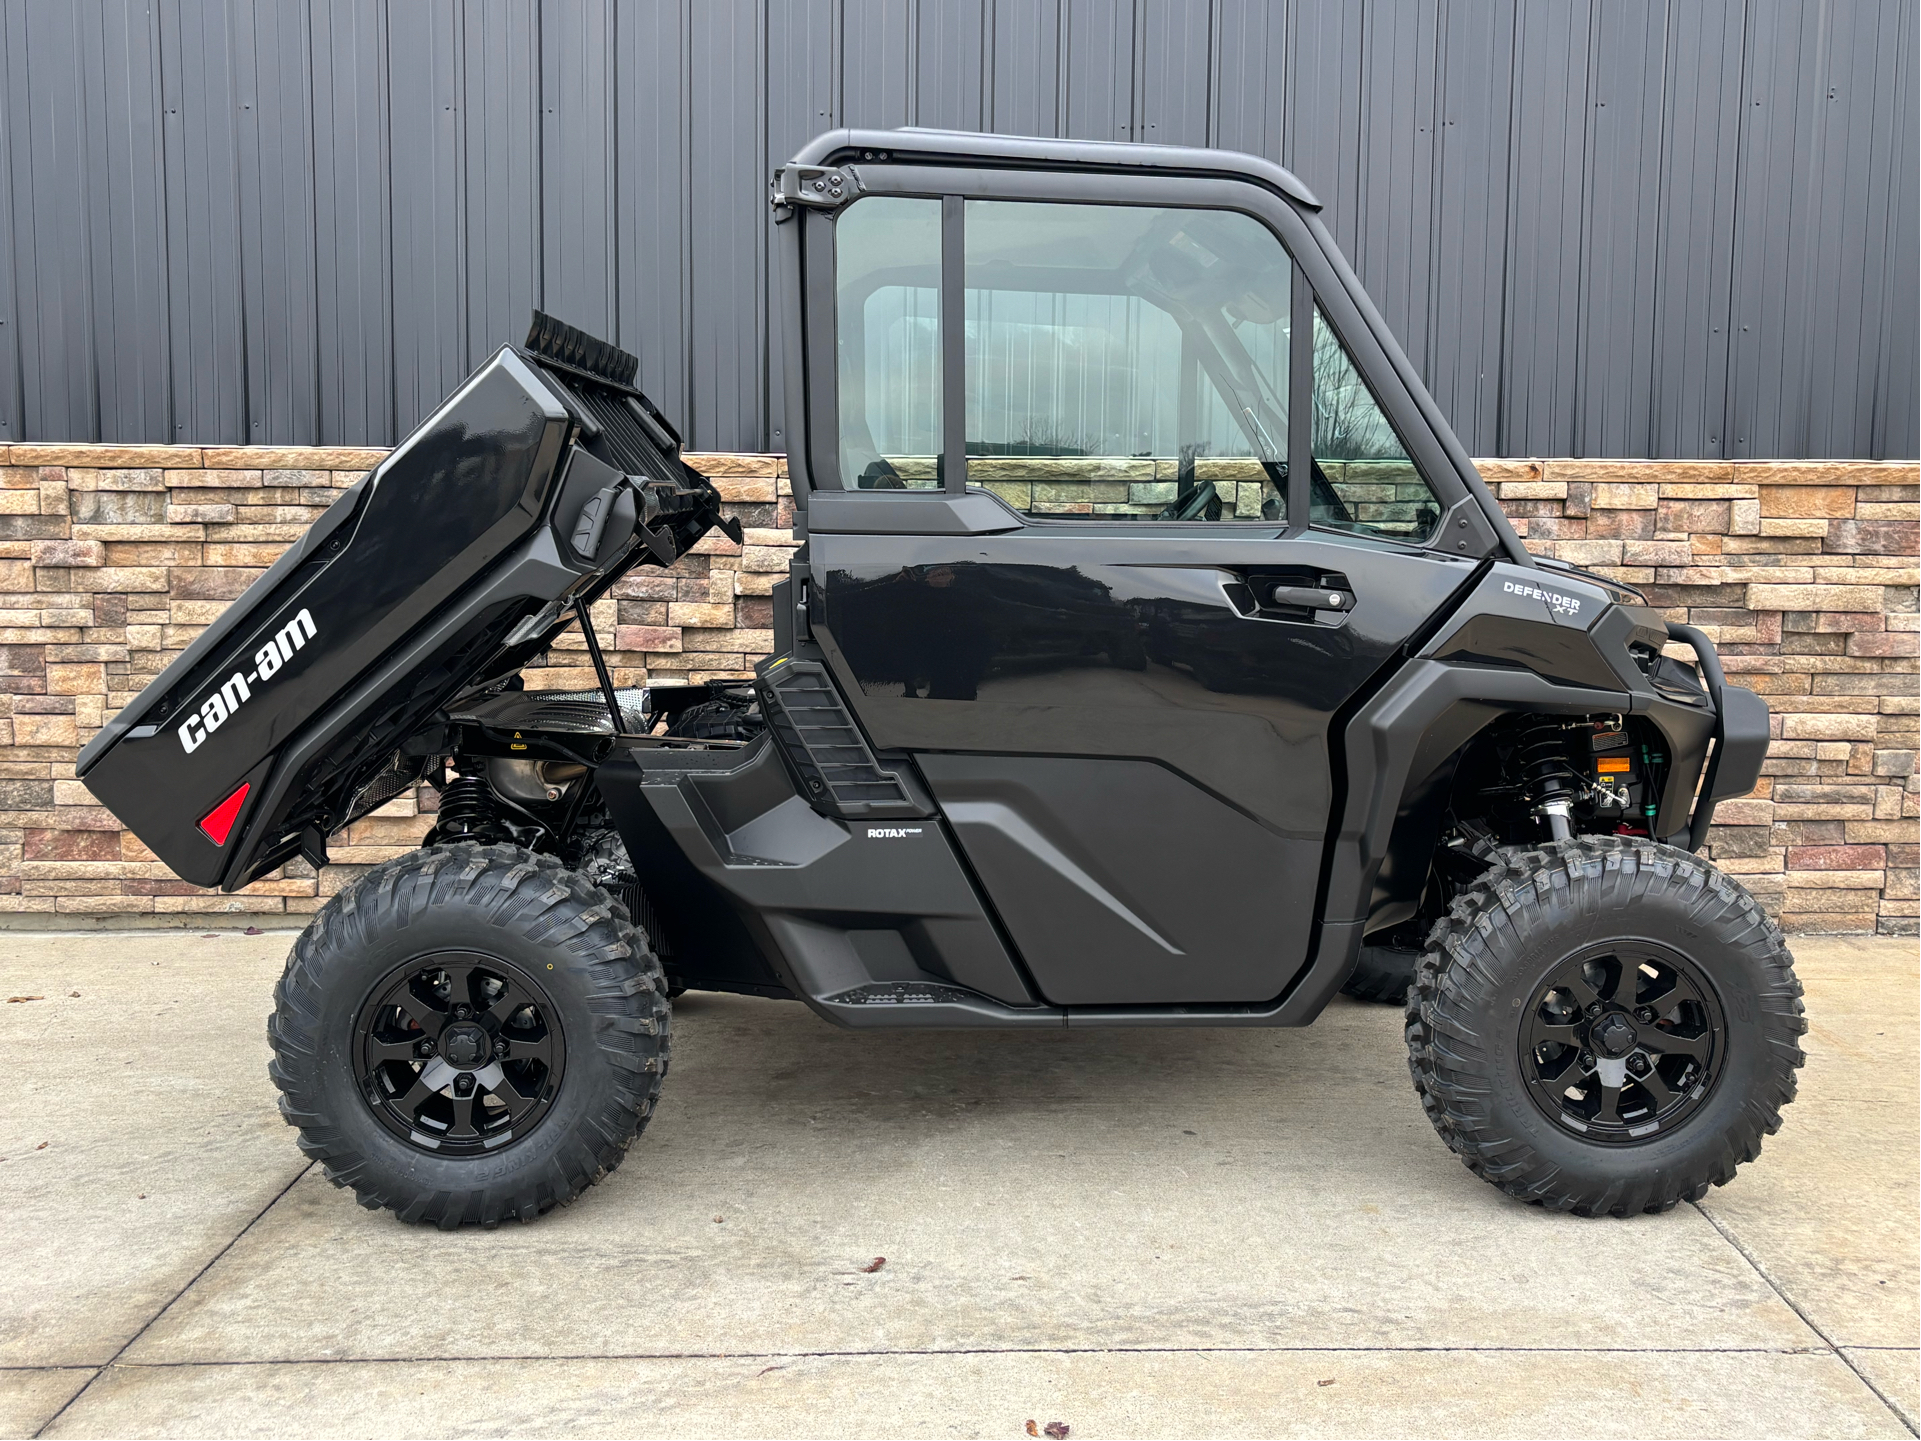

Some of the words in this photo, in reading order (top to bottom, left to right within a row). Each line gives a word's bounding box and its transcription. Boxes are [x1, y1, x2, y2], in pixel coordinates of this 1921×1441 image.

[1503, 581, 1581, 610] DEFENDER
[1552, 604, 1579, 616] XT
[177, 608, 318, 754] can-am
[867, 828, 906, 838] ROTAX
